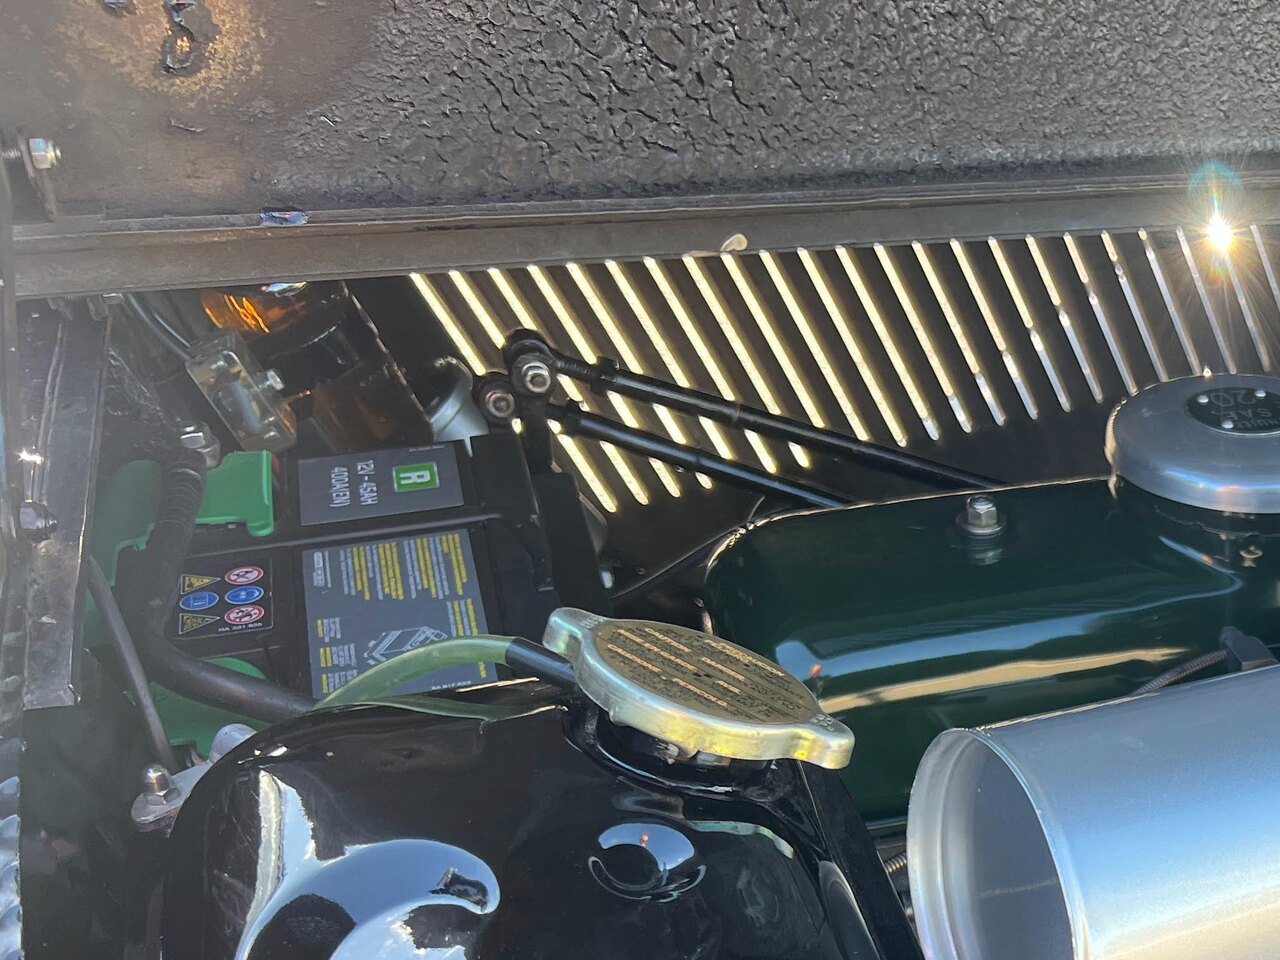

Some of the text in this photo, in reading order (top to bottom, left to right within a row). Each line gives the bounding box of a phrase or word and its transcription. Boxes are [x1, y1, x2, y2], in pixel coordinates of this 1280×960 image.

[357, 460, 375, 474] 12V
[399, 470, 430, 484] R
[644, 627, 691, 652] CAUTION
[672, 678, 727, 706] PERICOLO
